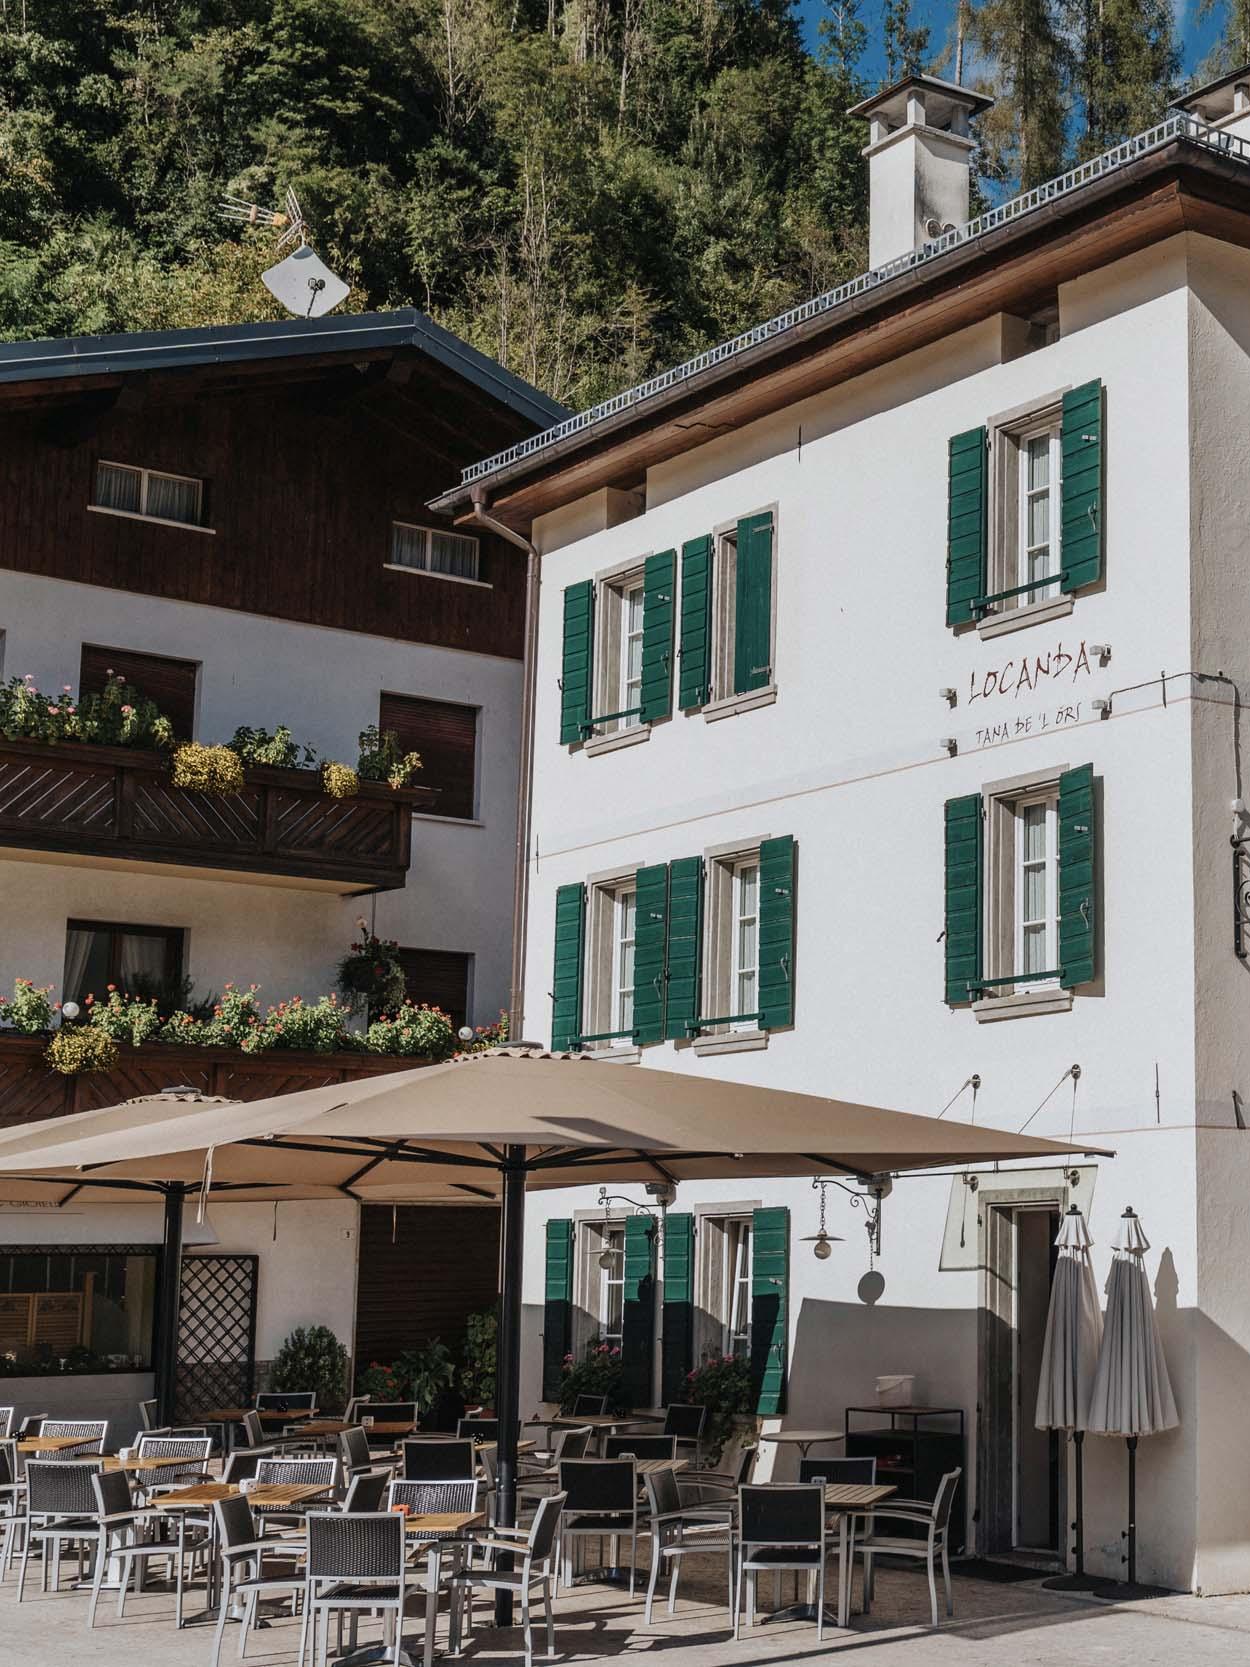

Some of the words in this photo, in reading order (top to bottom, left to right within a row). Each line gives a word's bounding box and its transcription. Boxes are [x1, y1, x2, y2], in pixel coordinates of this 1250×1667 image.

[968, 639, 1091, 705] LOCANDA
[975, 722, 1010, 748] TANA
[1014, 716, 1033, 735] DE
